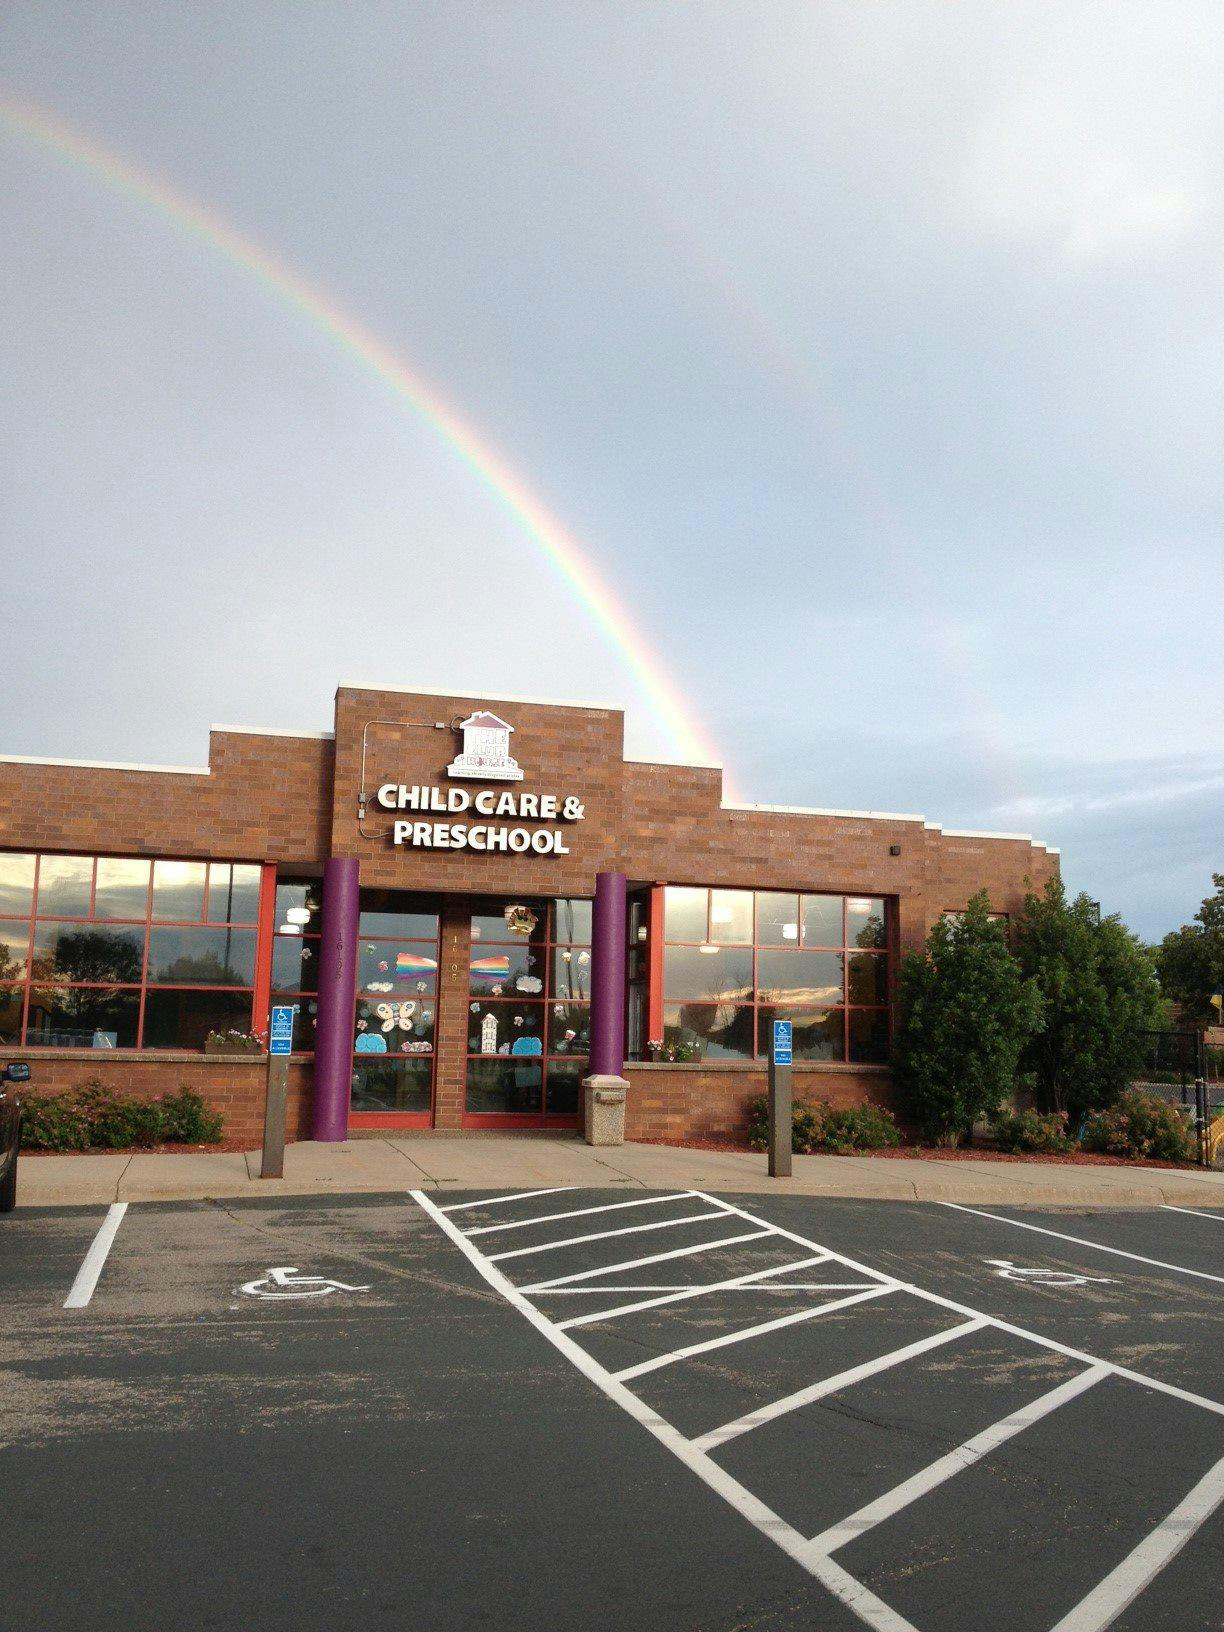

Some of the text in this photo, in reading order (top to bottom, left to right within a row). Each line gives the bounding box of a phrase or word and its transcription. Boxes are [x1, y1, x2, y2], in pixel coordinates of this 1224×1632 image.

[377, 784, 586, 820] CHILD CARE &
[394, 820, 570, 854] PRESCHOOL
